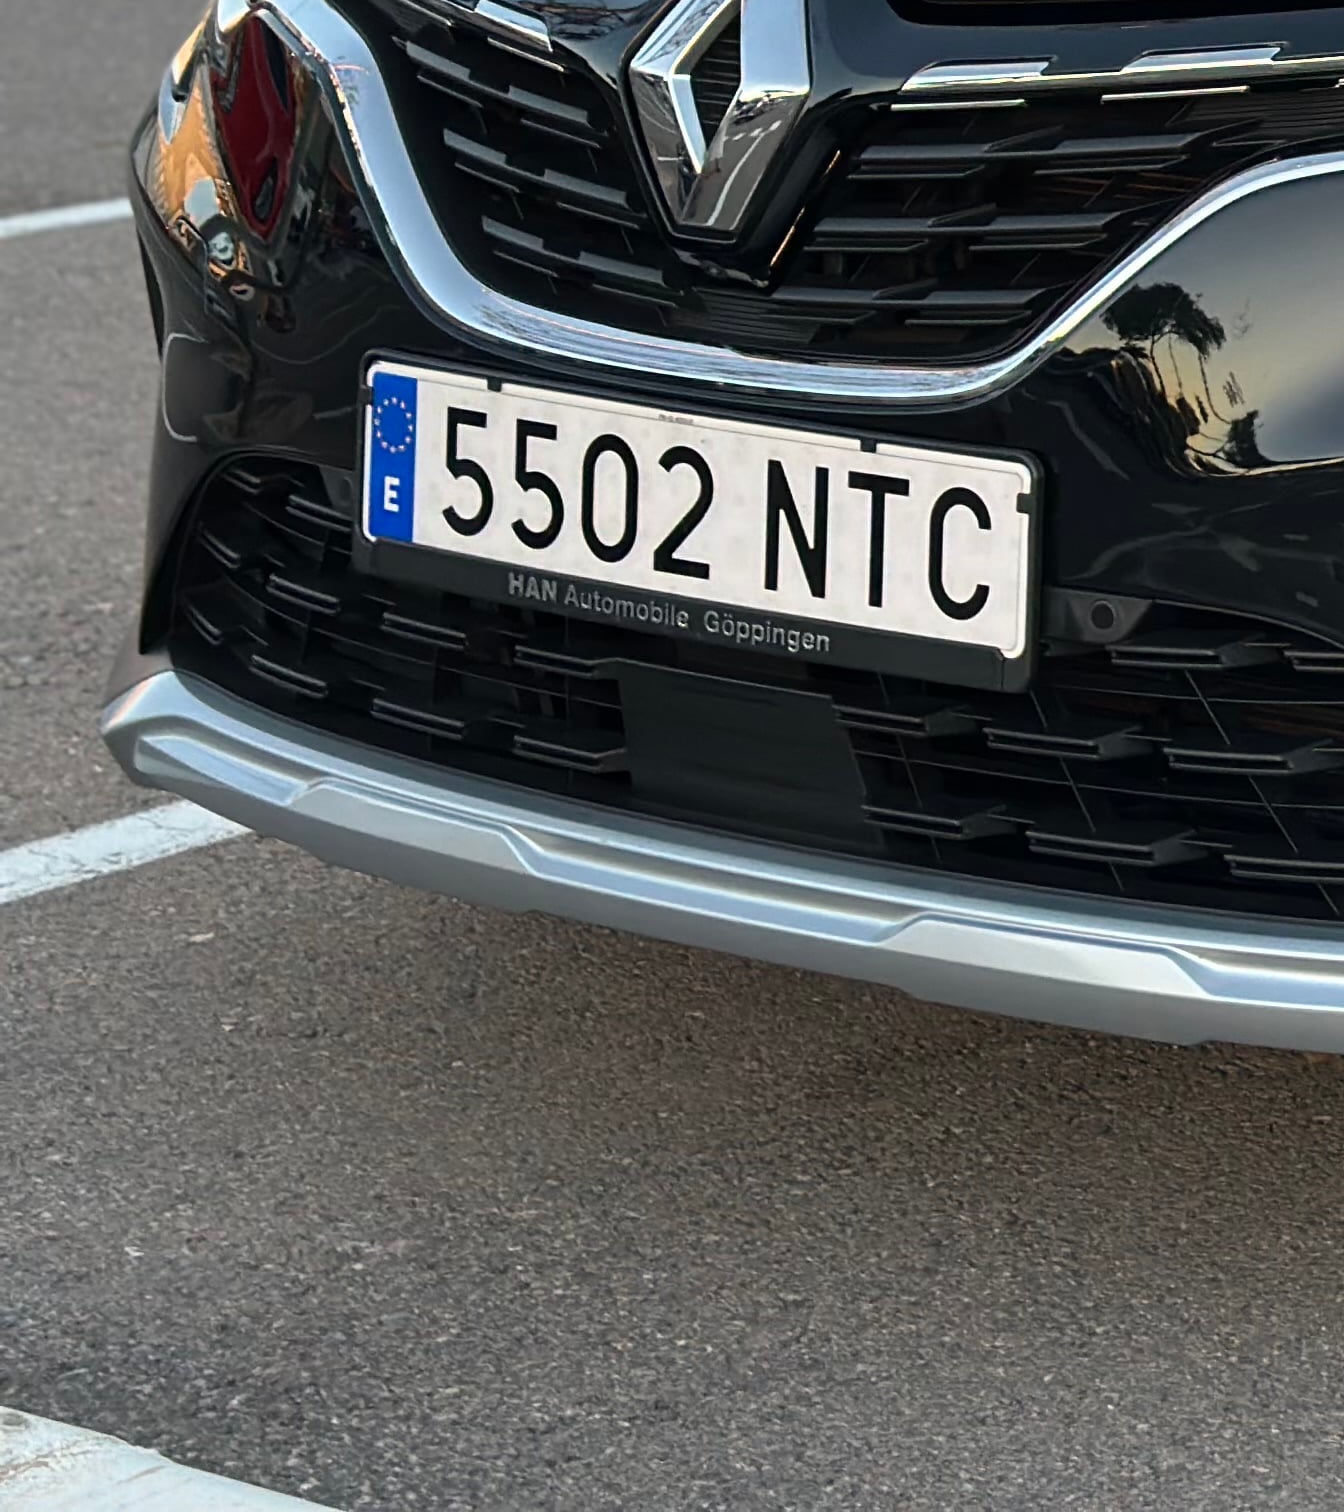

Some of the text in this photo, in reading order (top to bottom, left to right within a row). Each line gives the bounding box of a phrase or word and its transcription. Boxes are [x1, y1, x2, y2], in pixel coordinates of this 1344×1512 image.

[383, 476, 399, 513] E
[441, 406, 993, 621] 5502 NTC
[508, 572, 830, 653] HAN Automobile Göppingen
